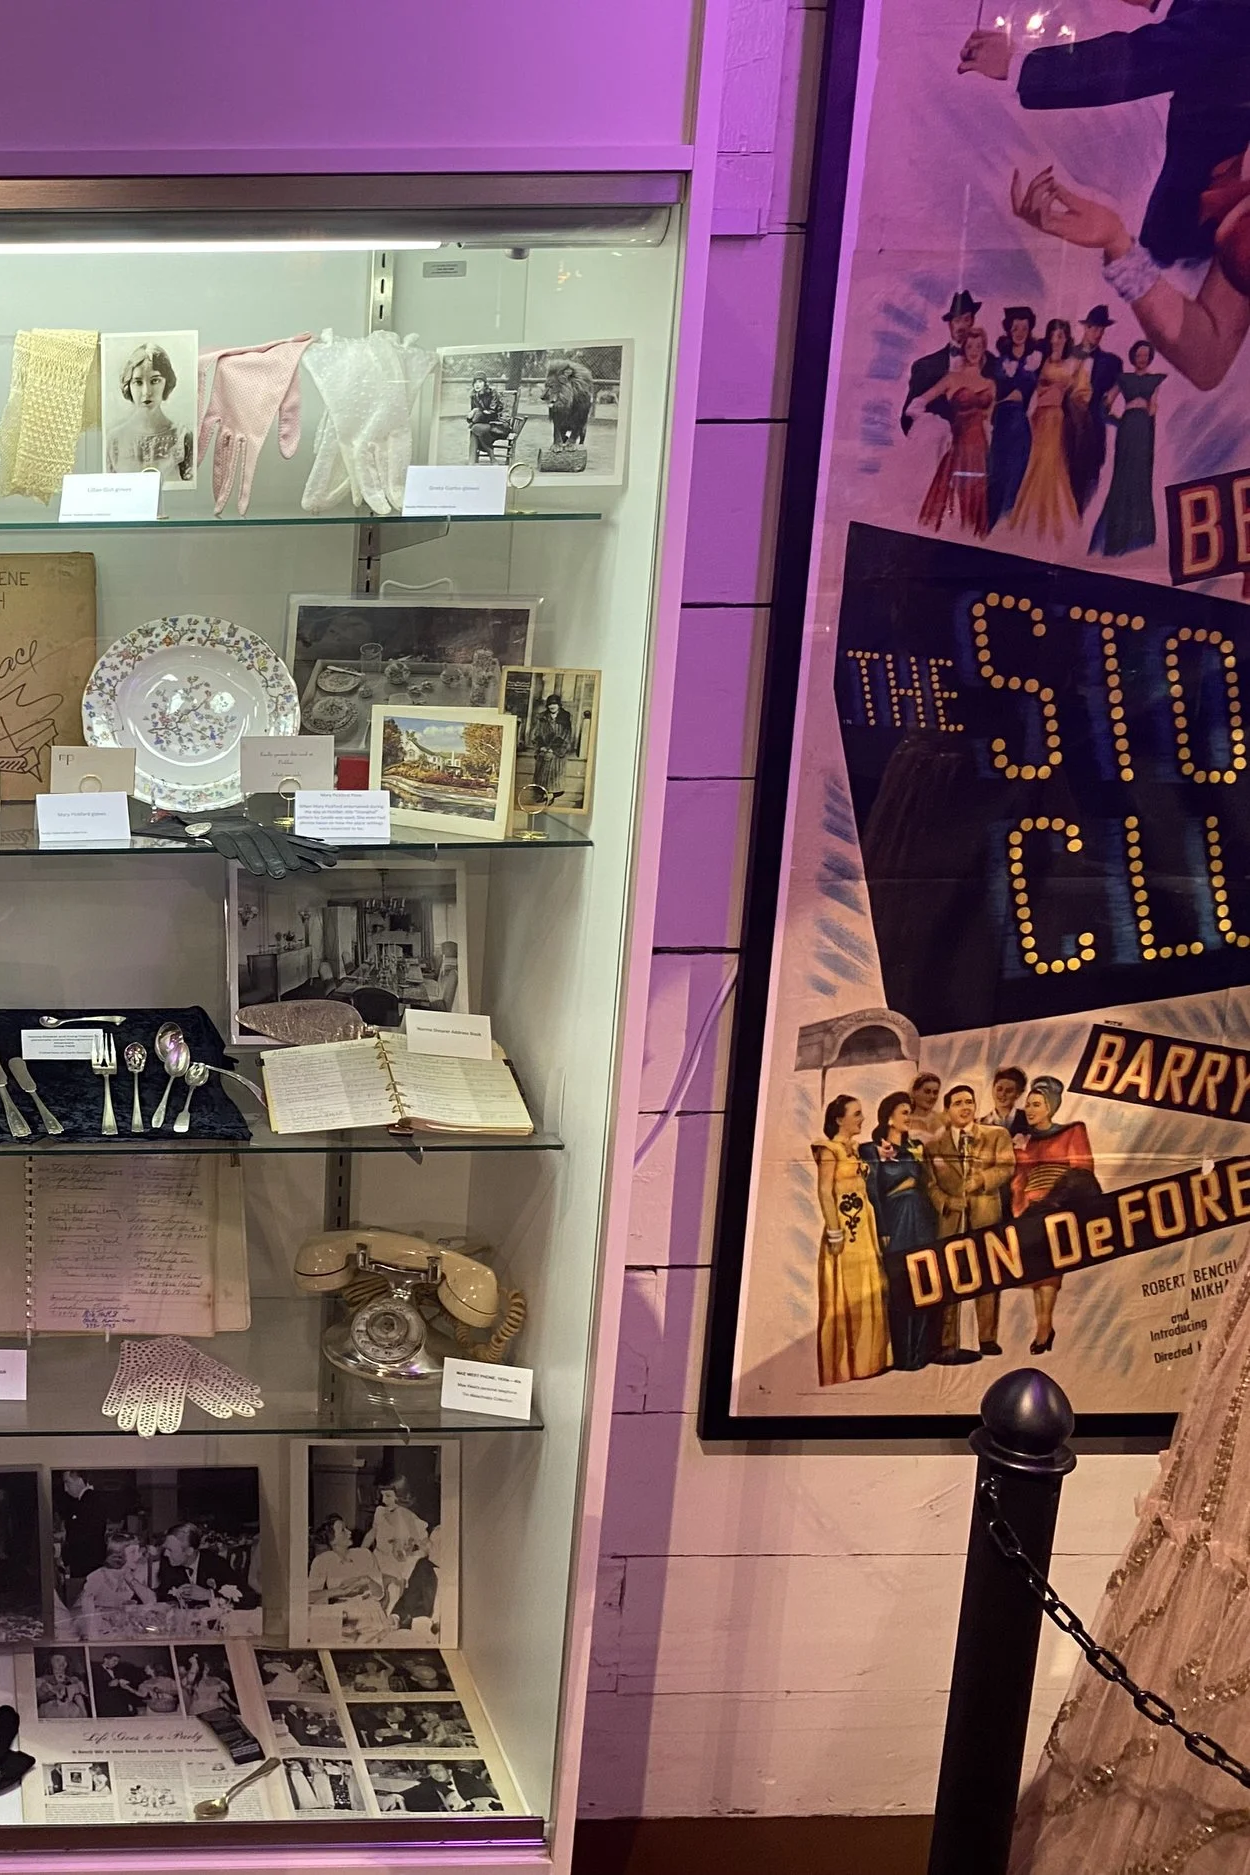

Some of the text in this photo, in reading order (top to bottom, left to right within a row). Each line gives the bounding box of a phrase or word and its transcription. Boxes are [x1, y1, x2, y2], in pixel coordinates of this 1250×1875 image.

[847, 592, 1247, 785] THE STO
[1082, 1033, 1250, 1114] BARRY
[906, 1160, 1250, 1308] DON DeFORE
[1142, 1273, 1185, 1297] ROBERT
[1171, 1308, 1190, 1324] and
[1150, 1319, 1208, 1342] Introducing
[1154, 1342, 1193, 1364] Directed
[82, 1732, 108, 1745] Life
[110, 1732, 139, 1742] Goes
[142, 1733, 152, 1741] to
[167, 1731, 203, 1745] Party
